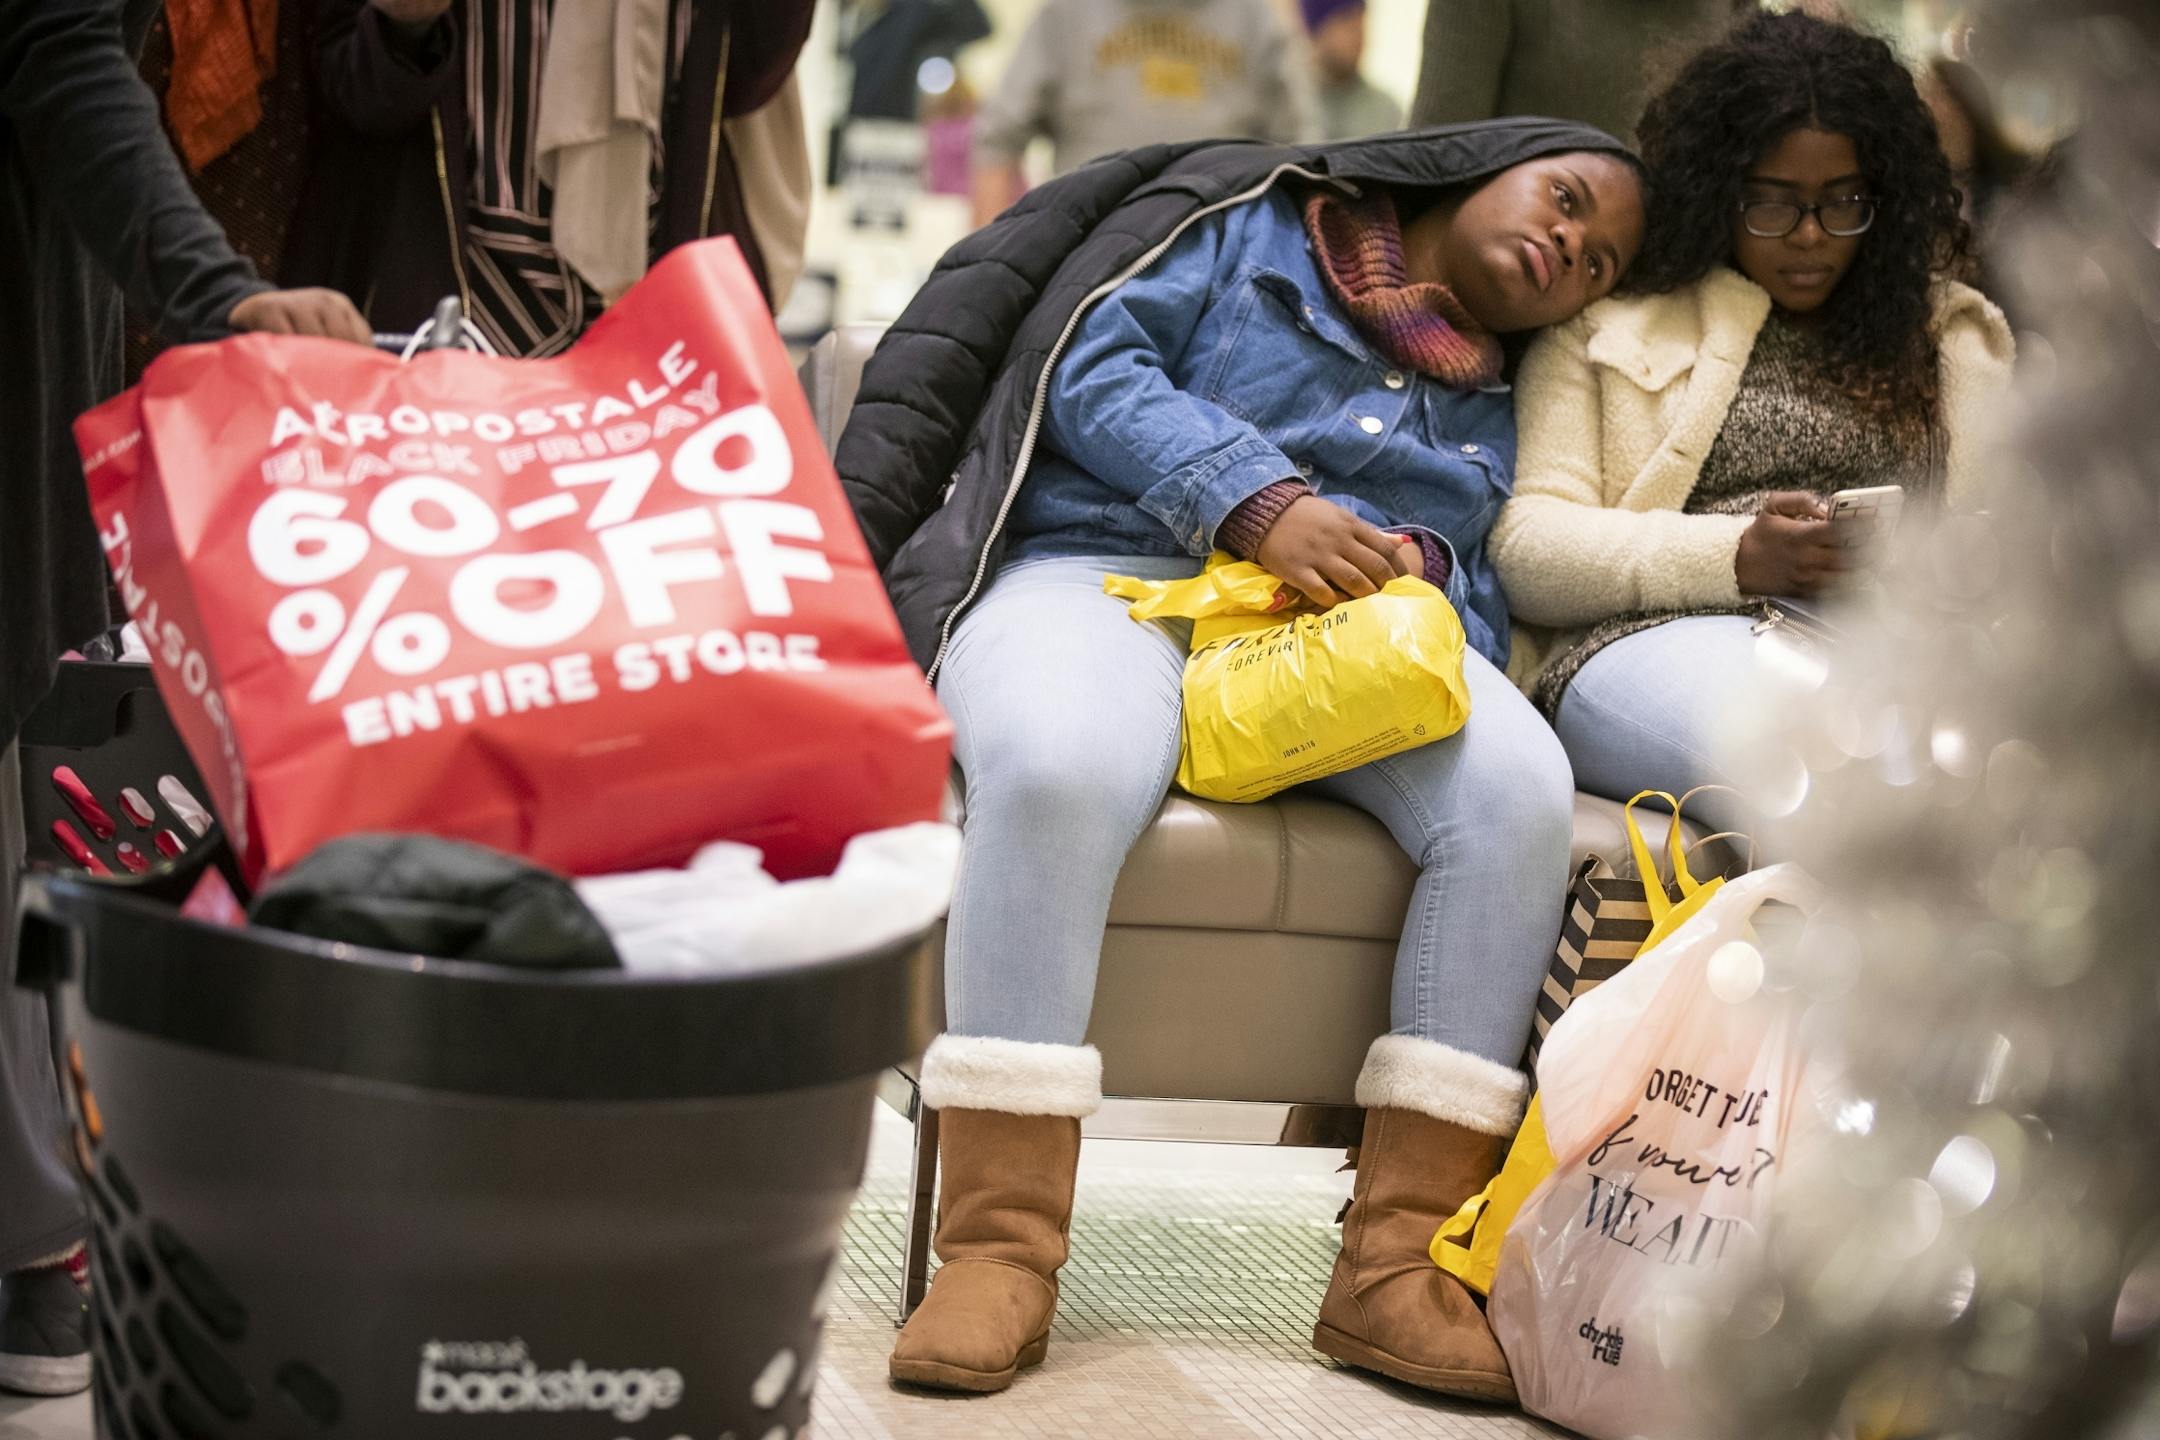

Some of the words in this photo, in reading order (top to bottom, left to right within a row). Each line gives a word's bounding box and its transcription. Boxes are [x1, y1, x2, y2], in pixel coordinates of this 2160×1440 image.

[260, 440, 481, 487] BLACK
[497, 370, 721, 475] FRIDAY
[341, 653, 599, 748] ENTIRE
[613, 628, 828, 692] STORE
[1282, 746, 1300, 759] JOHN
[1300, 740, 1316, 752] 3:16
[417, 1358, 685, 1422] backstage
